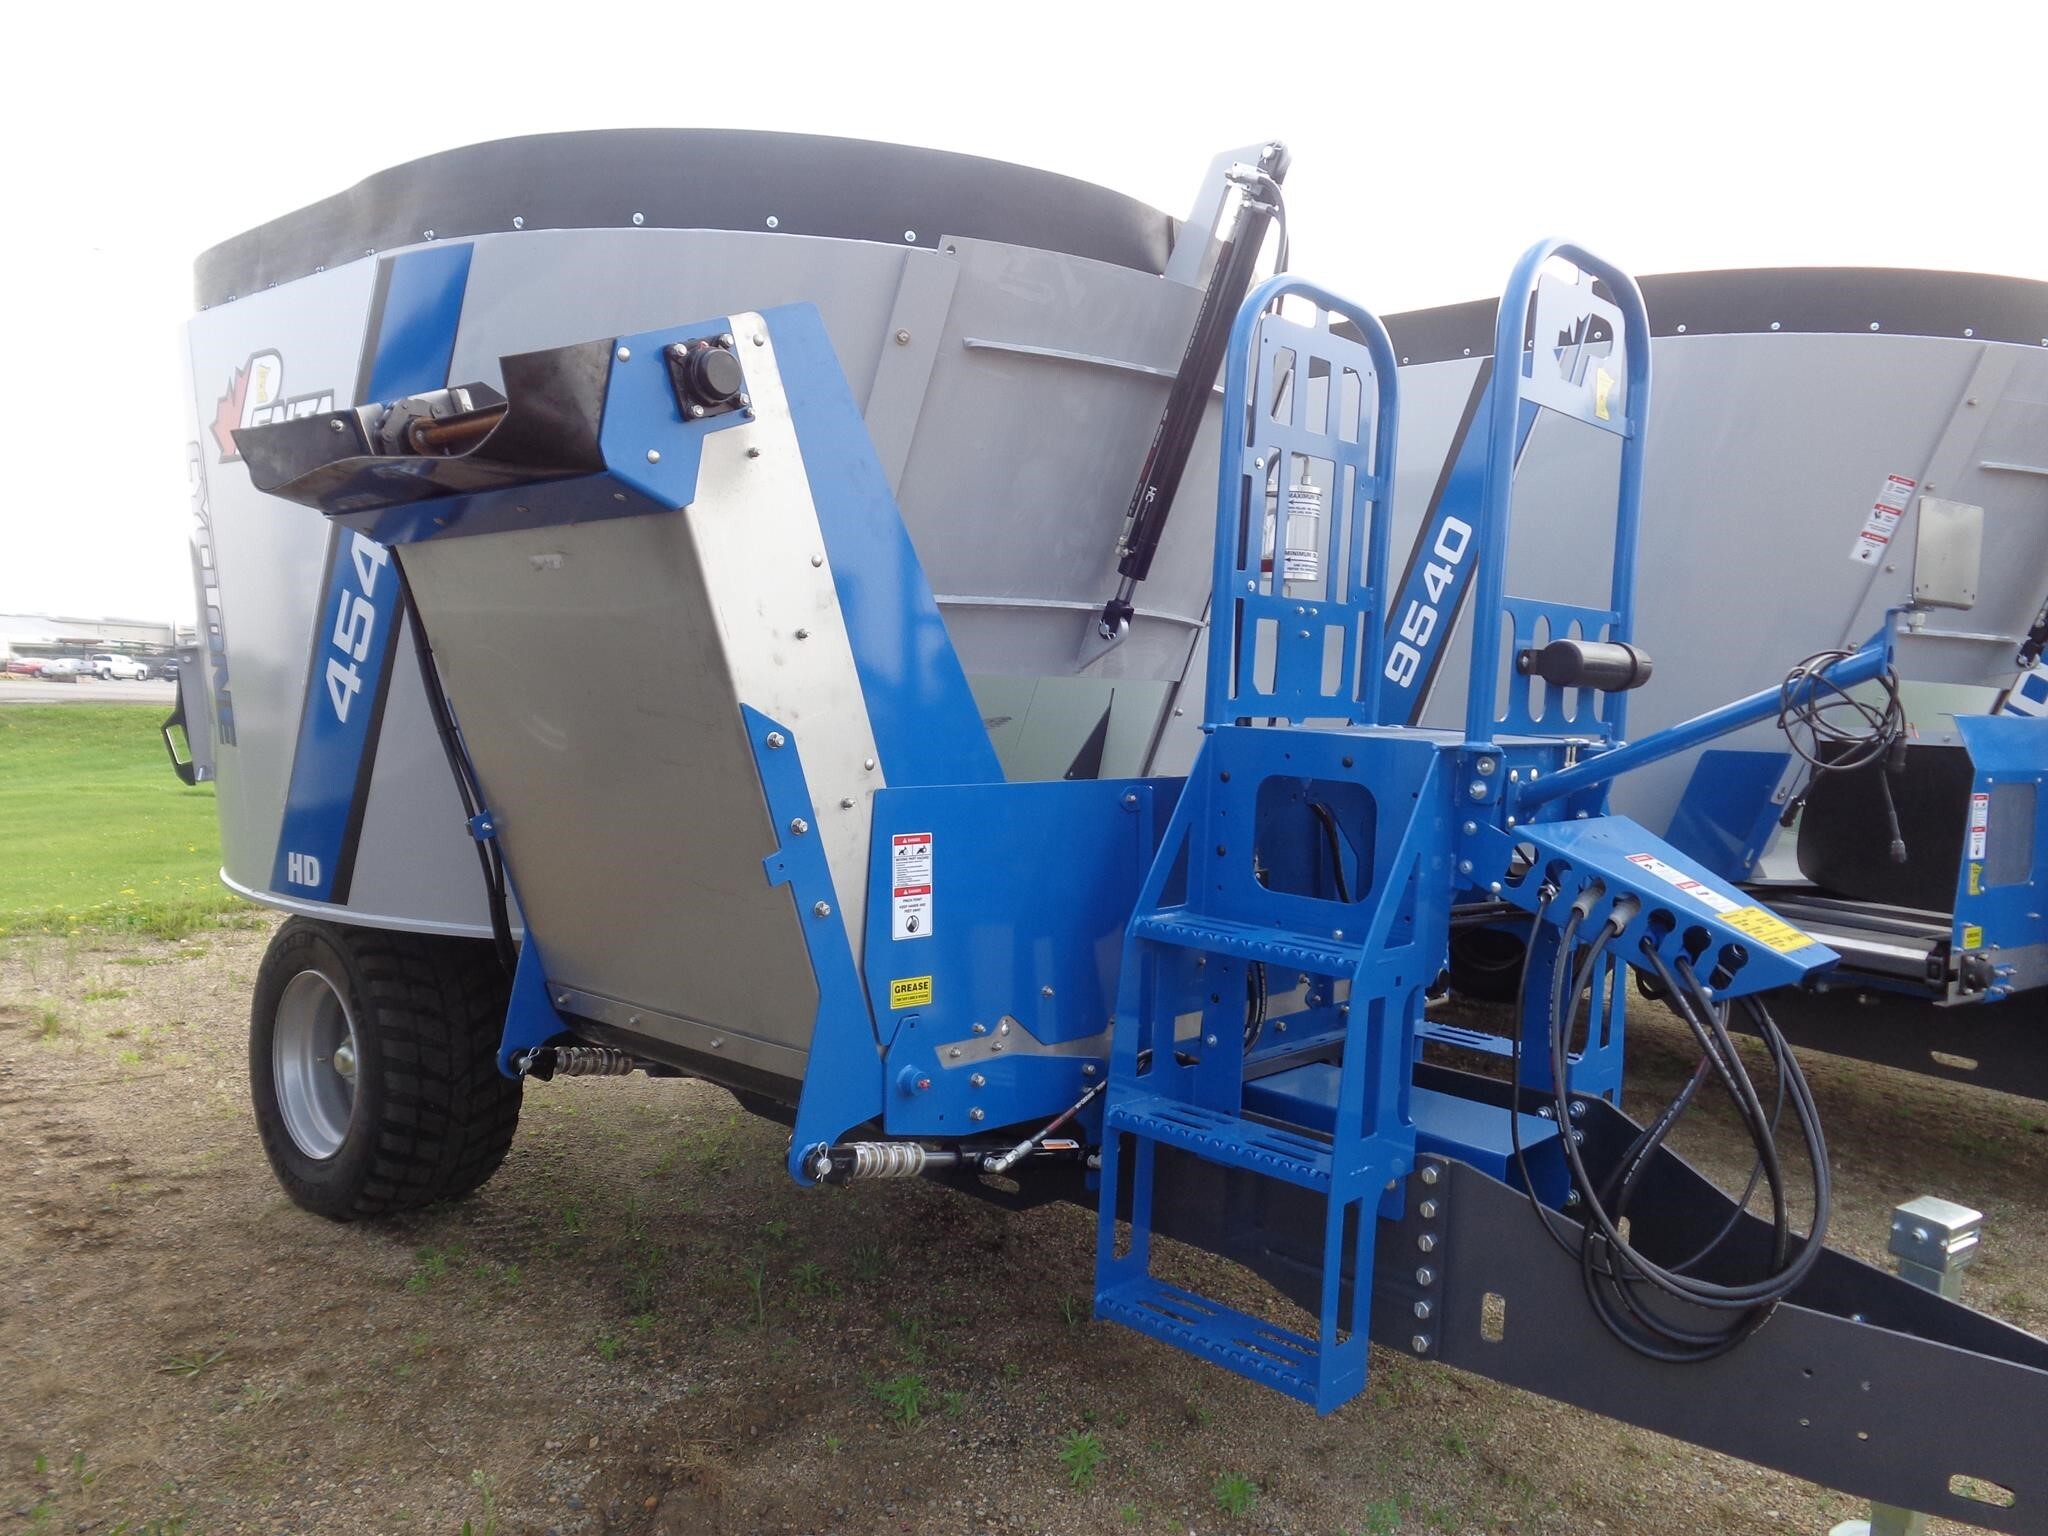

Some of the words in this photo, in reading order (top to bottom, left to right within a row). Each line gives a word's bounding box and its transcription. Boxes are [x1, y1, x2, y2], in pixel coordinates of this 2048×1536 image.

[1384, 516, 1472, 688] 9540
[287, 852, 321, 887] HD
[894, 981, 929, 994] GREASE
